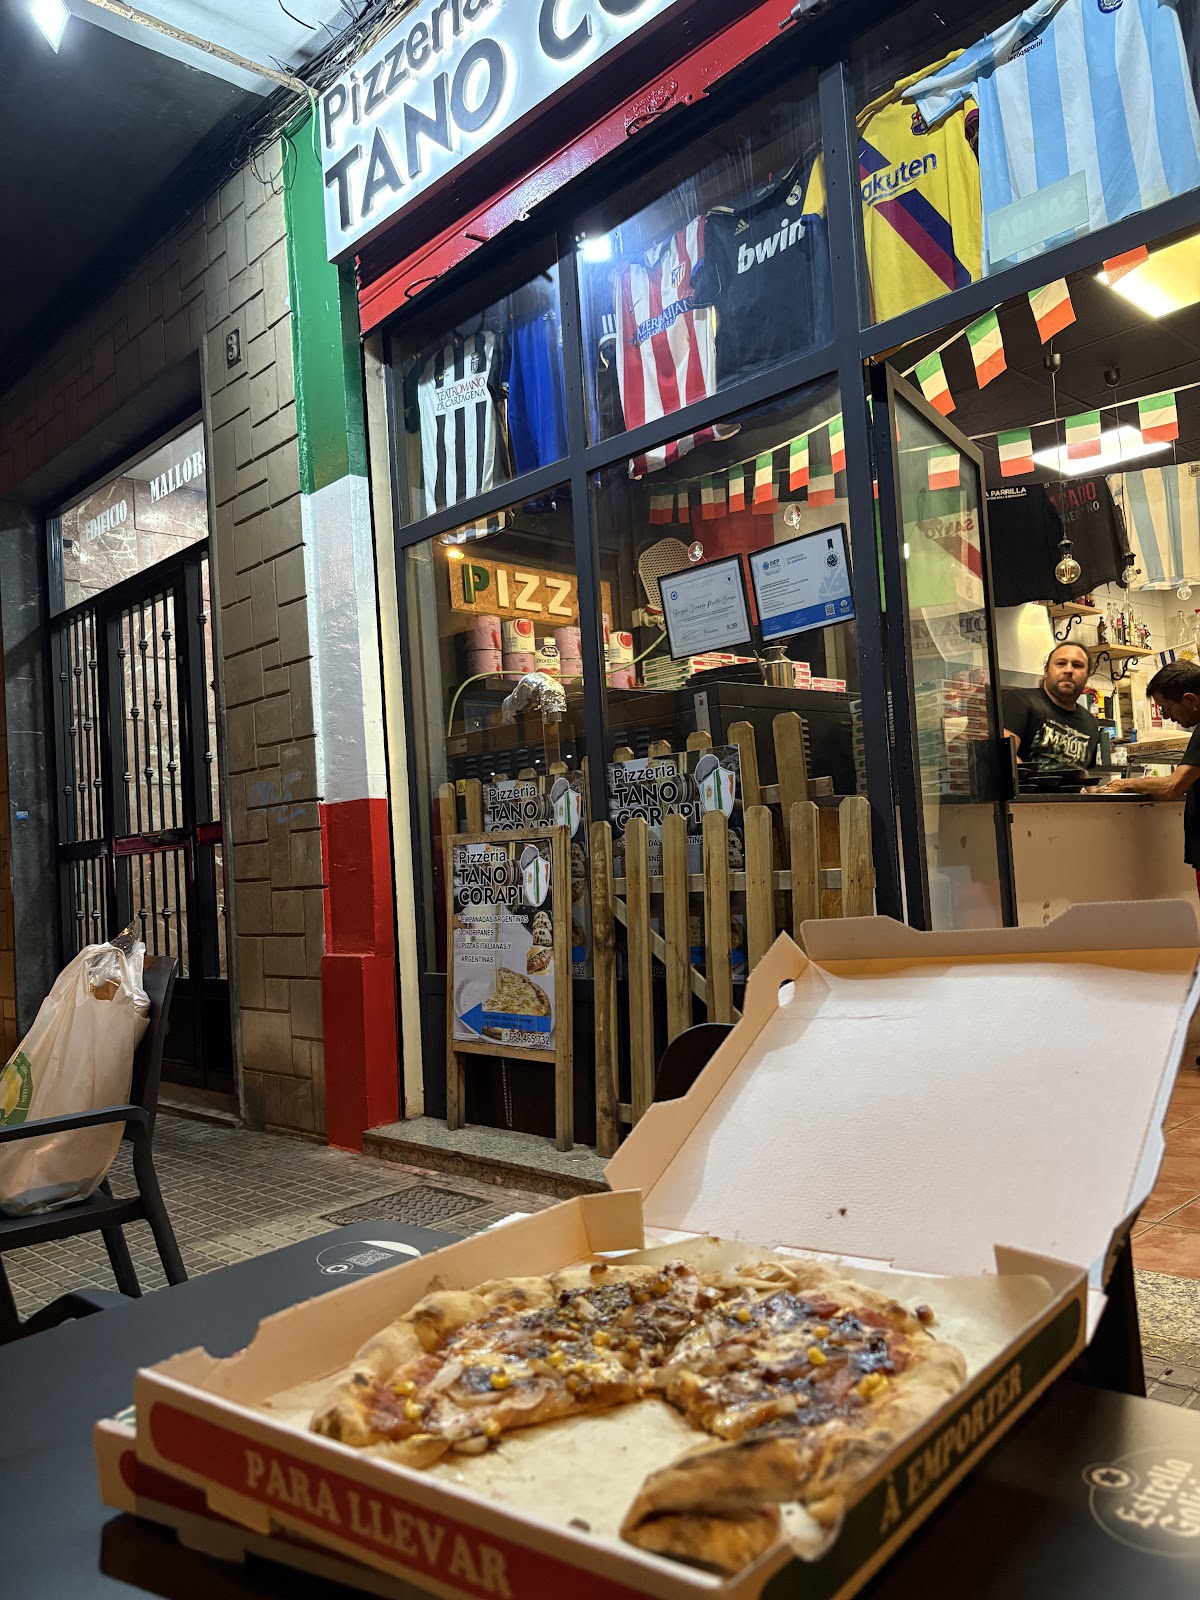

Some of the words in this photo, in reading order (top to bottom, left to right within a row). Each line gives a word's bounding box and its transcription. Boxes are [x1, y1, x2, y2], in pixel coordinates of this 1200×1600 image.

[325, 38, 505, 232] TANO
[862, 153, 938, 202] akuten
[737, 218, 806, 274] bwin
[445, 388, 486, 408] CARTAGENA
[990, 486, 1027, 497] PARRILLA
[85, 499, 127, 543] EDIFICIO
[462, 563, 573, 617] PIZZ
[613, 762, 676, 784] Pizzería
[488, 783, 536, 802] Pizzería
[613, 781, 678, 808] TANO
[488, 801, 538, 823] TANO
[459, 849, 506, 864] Pizzería
[458, 866, 507, 885] TANO
[458, 886, 524, 906] CORAPI
[494, 915, 529, 923] ARGENTINAS
[461, 942, 479, 950] PIZZAS
[481, 942, 507, 950] ITALIANAS
[461, 955, 494, 963] ARGENTINAS
[906, 1362, 1022, 1507] EMPORTER
[1115, 1458, 1195, 1529] Estrella
[245, 1450, 341, 1525] PARA
[347, 1490, 512, 1598] LLEVAR
